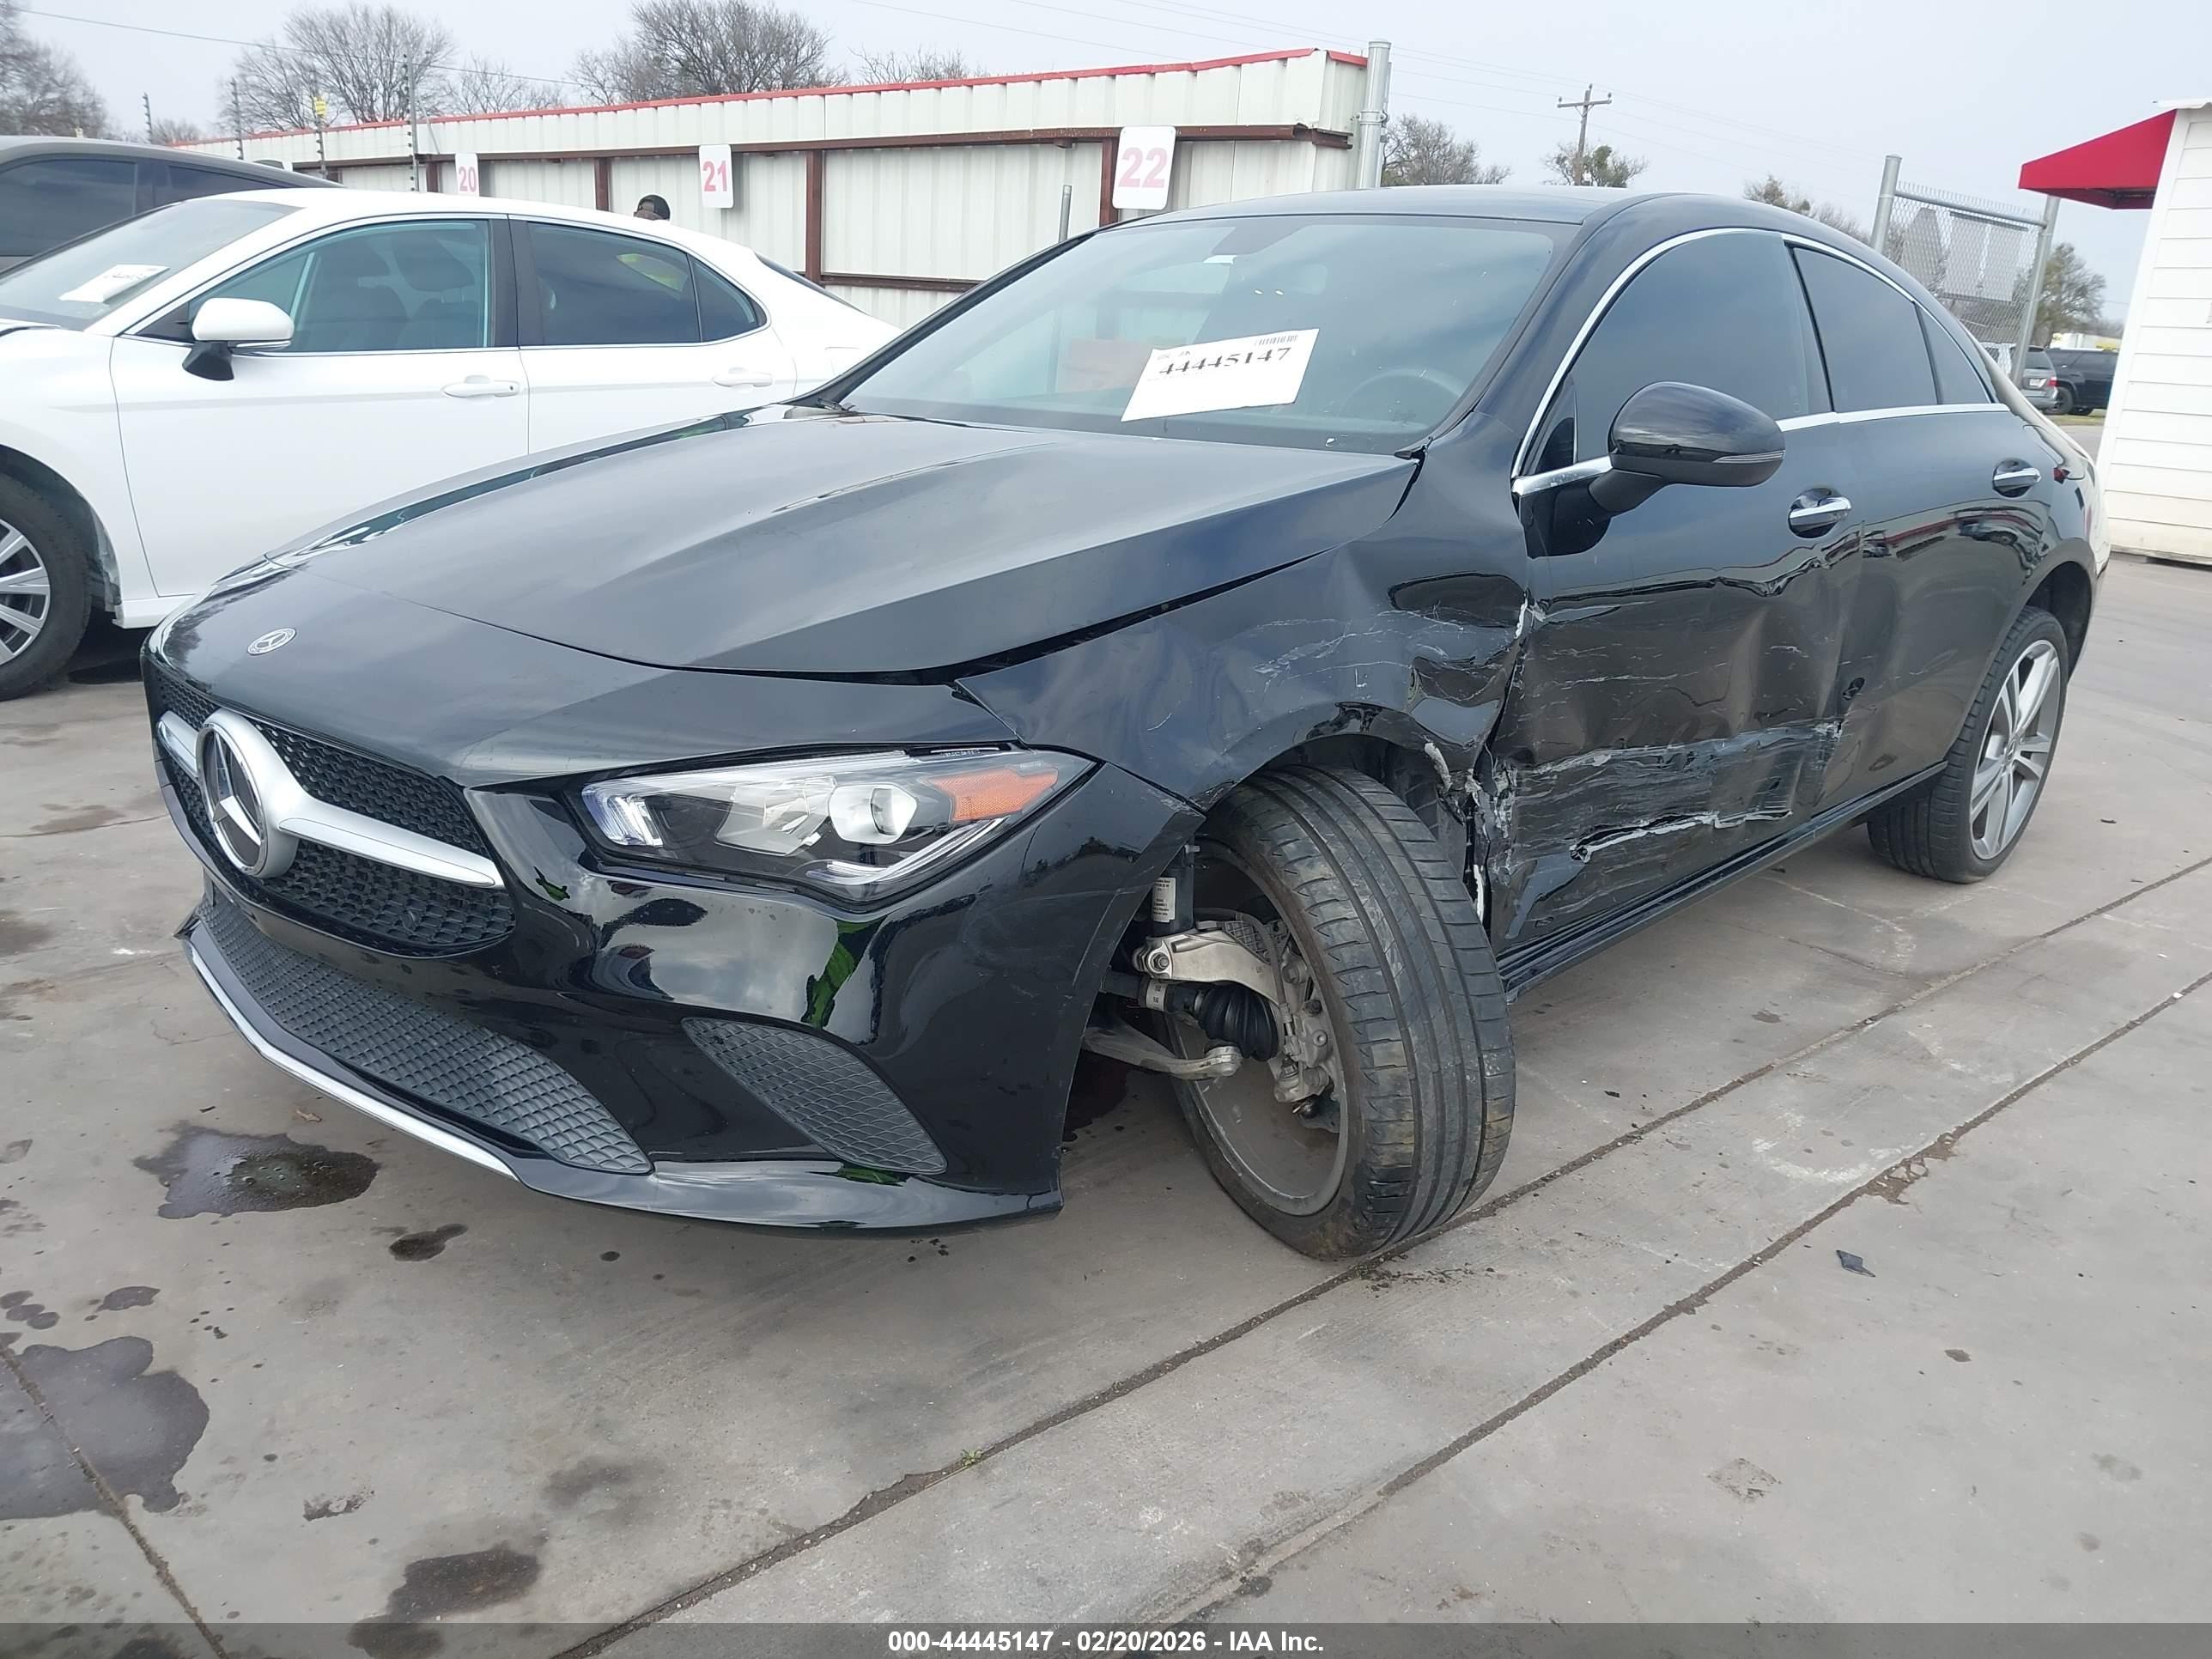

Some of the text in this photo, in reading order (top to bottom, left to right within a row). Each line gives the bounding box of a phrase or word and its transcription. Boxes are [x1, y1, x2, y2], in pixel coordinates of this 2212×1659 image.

[458, 166, 477, 192] 20
[703, 160, 727, 192] 21
[1118, 147, 1168, 188] 22
[1159, 347, 1291, 374] 44445147
